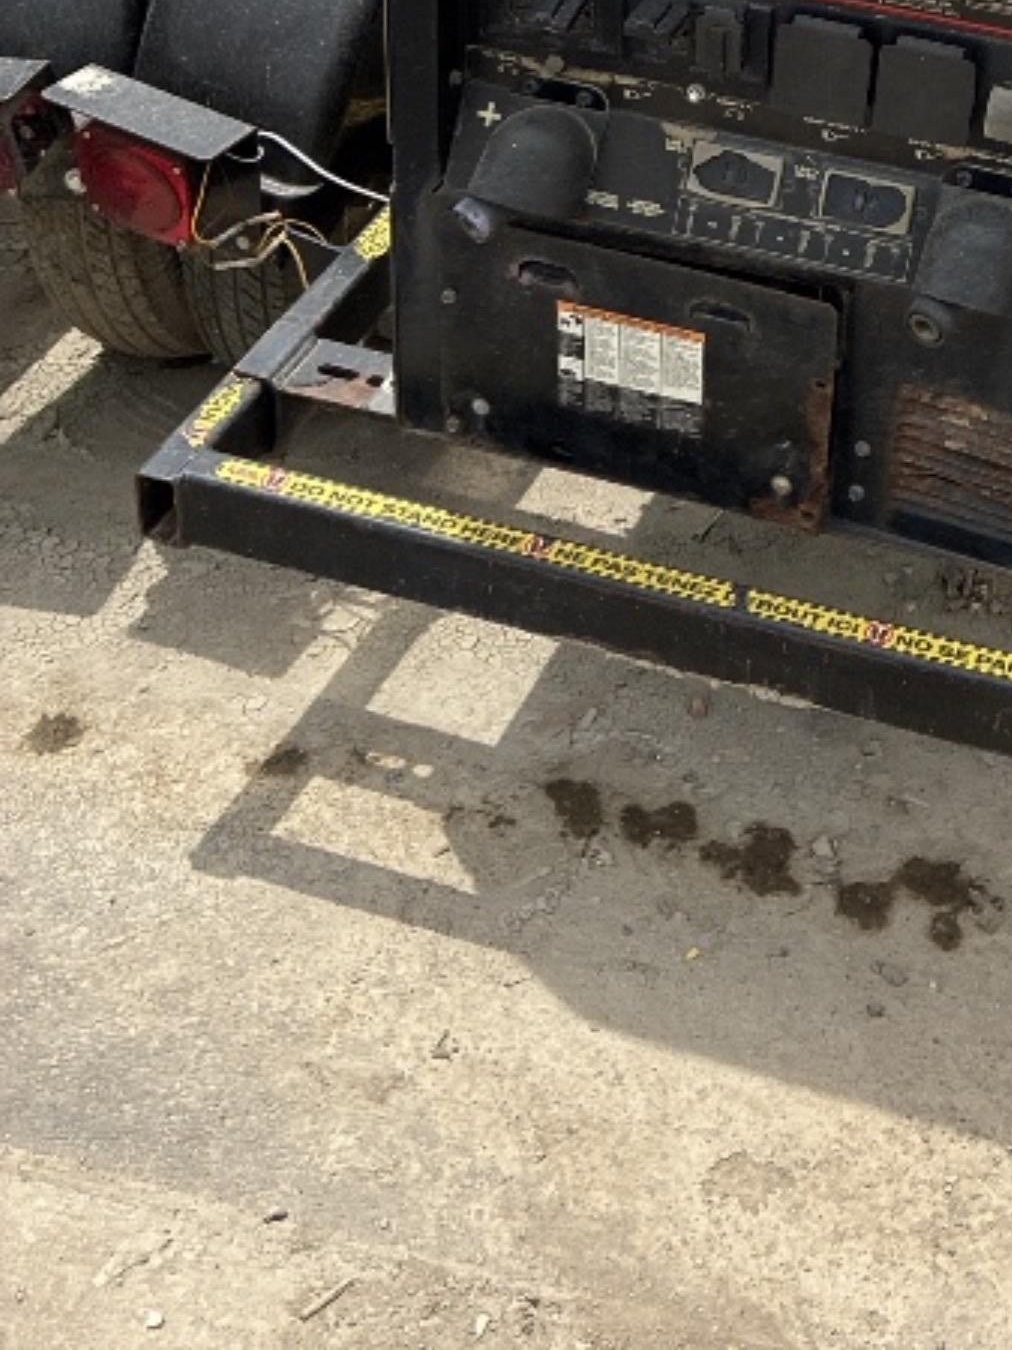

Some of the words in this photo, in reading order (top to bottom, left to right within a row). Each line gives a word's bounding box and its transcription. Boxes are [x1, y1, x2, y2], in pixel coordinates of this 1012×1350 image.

[290, 481, 325, 497] DO
[329, 490, 378, 508] NOT
[894, 634, 932, 651] NO
